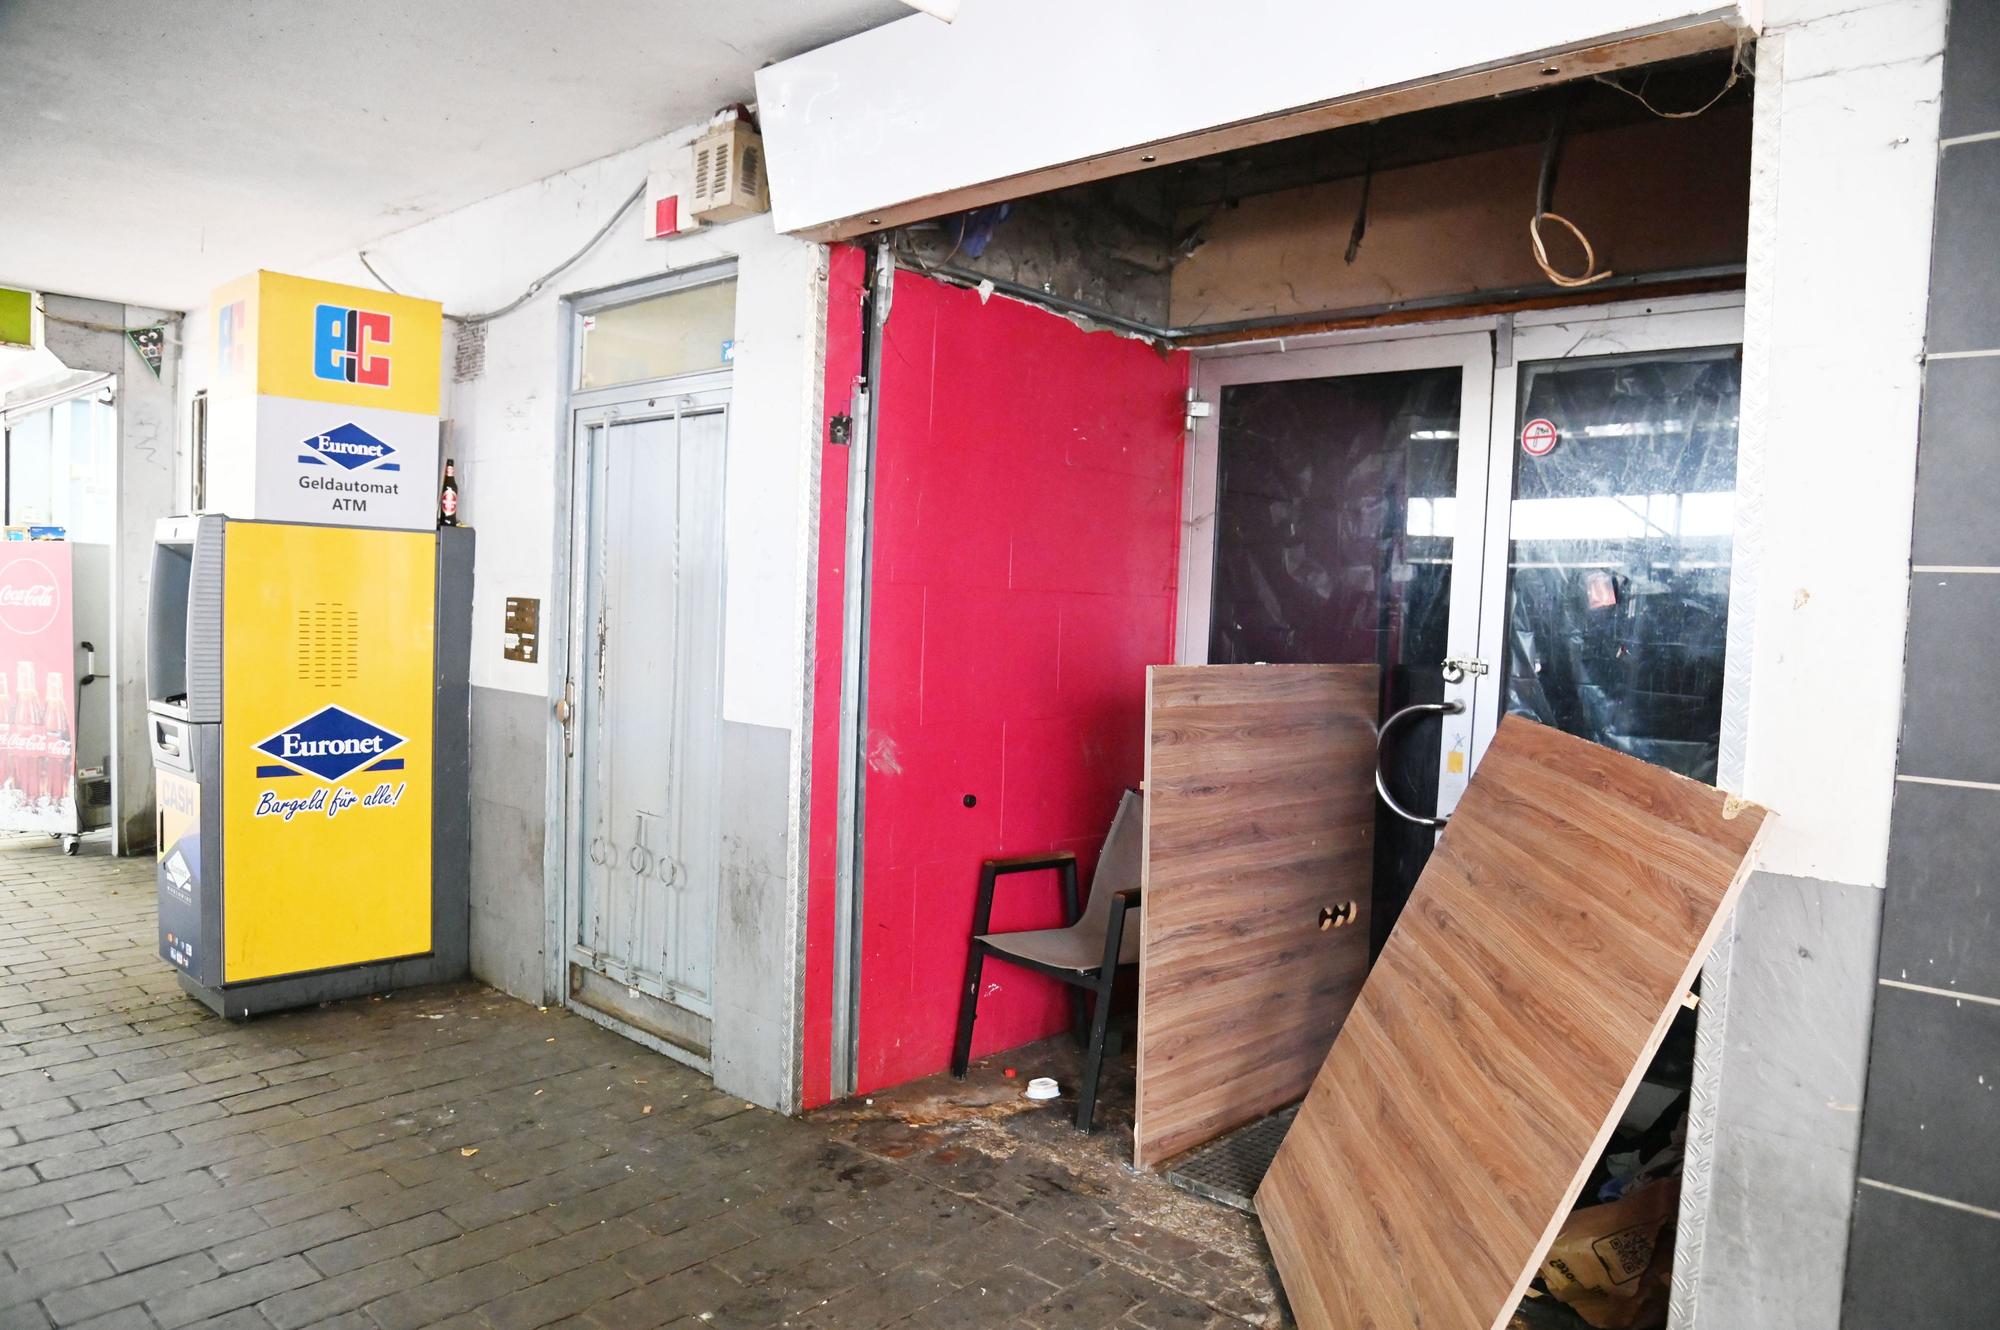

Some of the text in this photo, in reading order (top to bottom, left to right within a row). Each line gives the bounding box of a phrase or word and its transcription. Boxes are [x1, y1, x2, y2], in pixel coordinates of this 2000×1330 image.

[318, 435, 384, 457] Euronet
[298, 475, 399, 495] Geldautomat
[332, 497, 367, 512] ATM
[280, 733, 383, 758] Euronet
[162, 779, 194, 817] CASH
[256, 783, 405, 821] Bargeld für alle!
